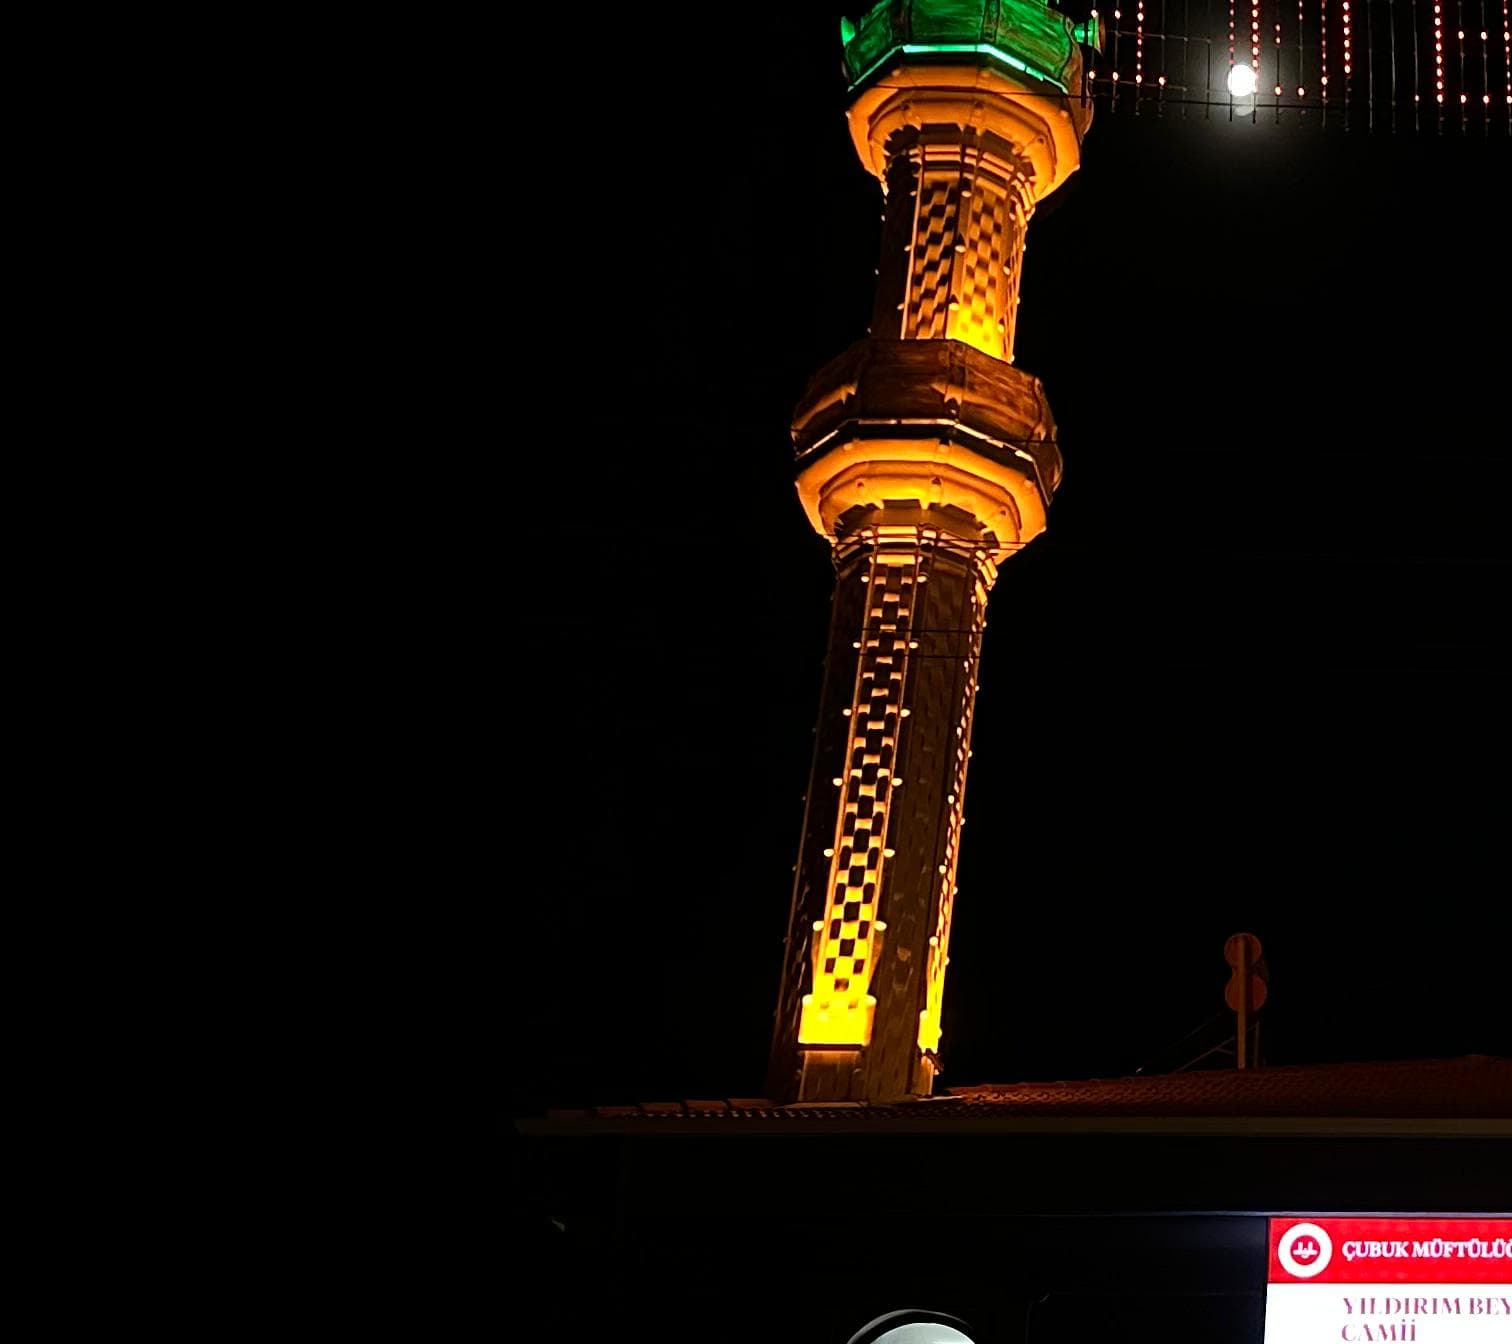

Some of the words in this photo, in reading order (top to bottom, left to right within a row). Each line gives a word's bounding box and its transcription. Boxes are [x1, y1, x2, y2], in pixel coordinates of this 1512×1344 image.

[1341, 1240, 1410, 1262] ÇUBUK
[1342, 1296, 1462, 1316] YILDIRIM
[1341, 1319, 1418, 1343] CAMİİ
